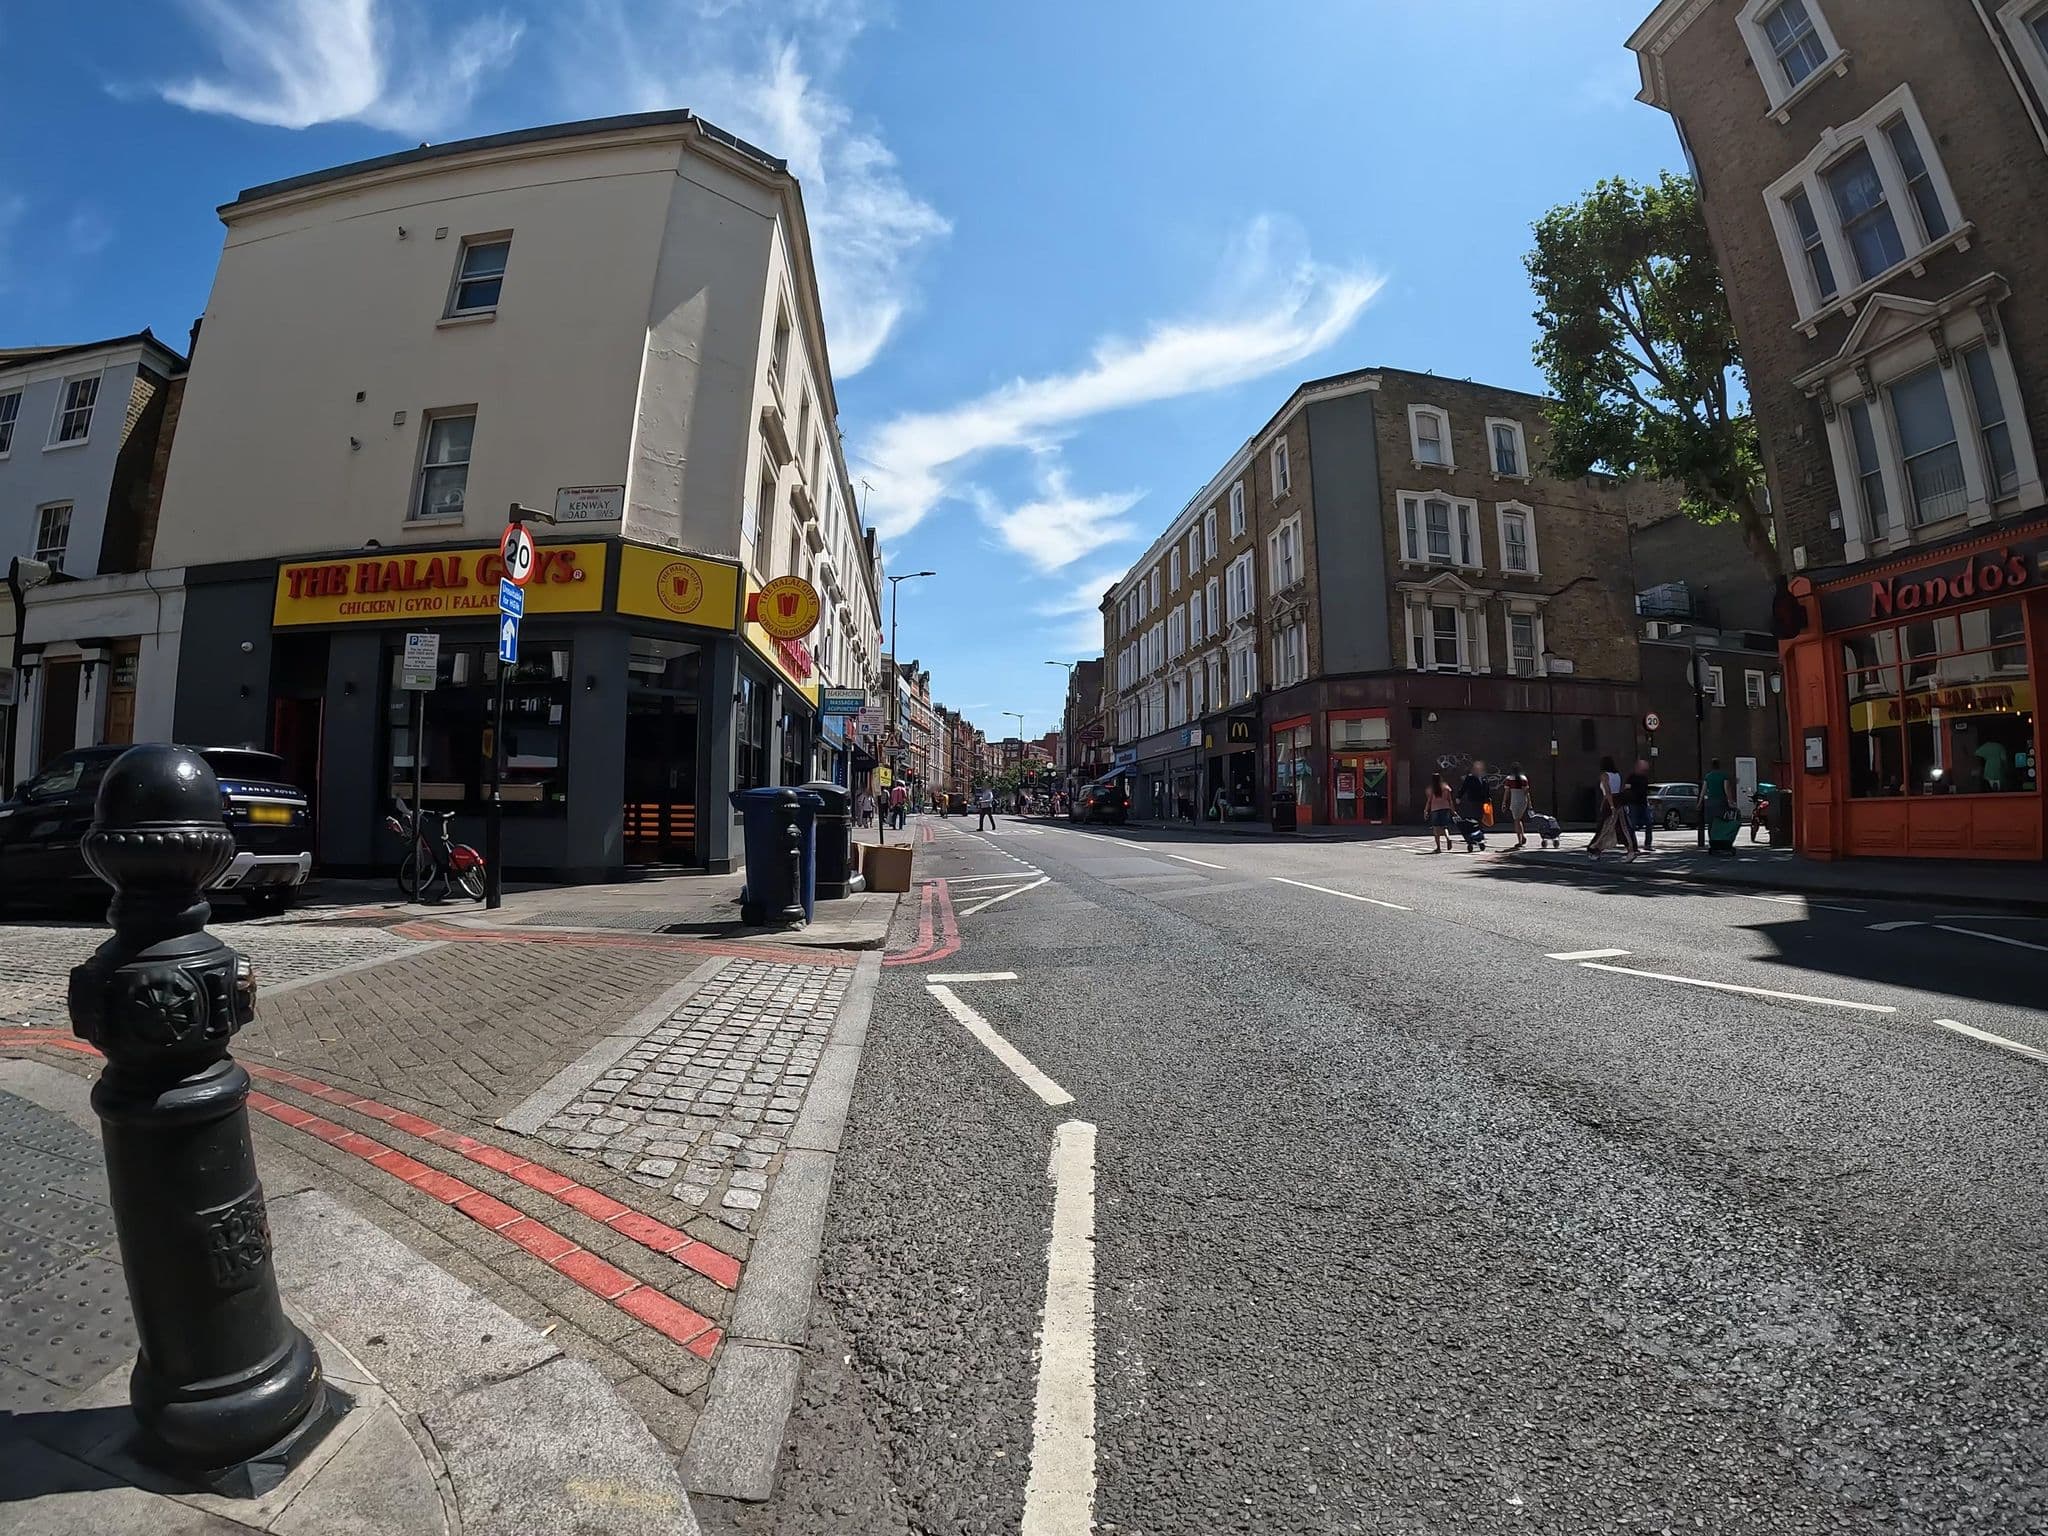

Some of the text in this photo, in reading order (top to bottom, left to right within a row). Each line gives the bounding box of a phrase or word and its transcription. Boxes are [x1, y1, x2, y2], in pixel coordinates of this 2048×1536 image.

[566, 511, 588, 520] OAD
[569, 500, 610, 511] KENWAY
[506, 538, 530, 569] 20
[285, 549, 577, 599] THE HALAL GYS
[1870, 547, 2028, 618] Nando's
[761, 578, 817, 606] THE HALAL GUYS
[339, 594, 498, 615] CHICKEN GYRO FALAF
[760, 613, 775, 630] GYRO
[1647, 717, 1658, 726] 20
